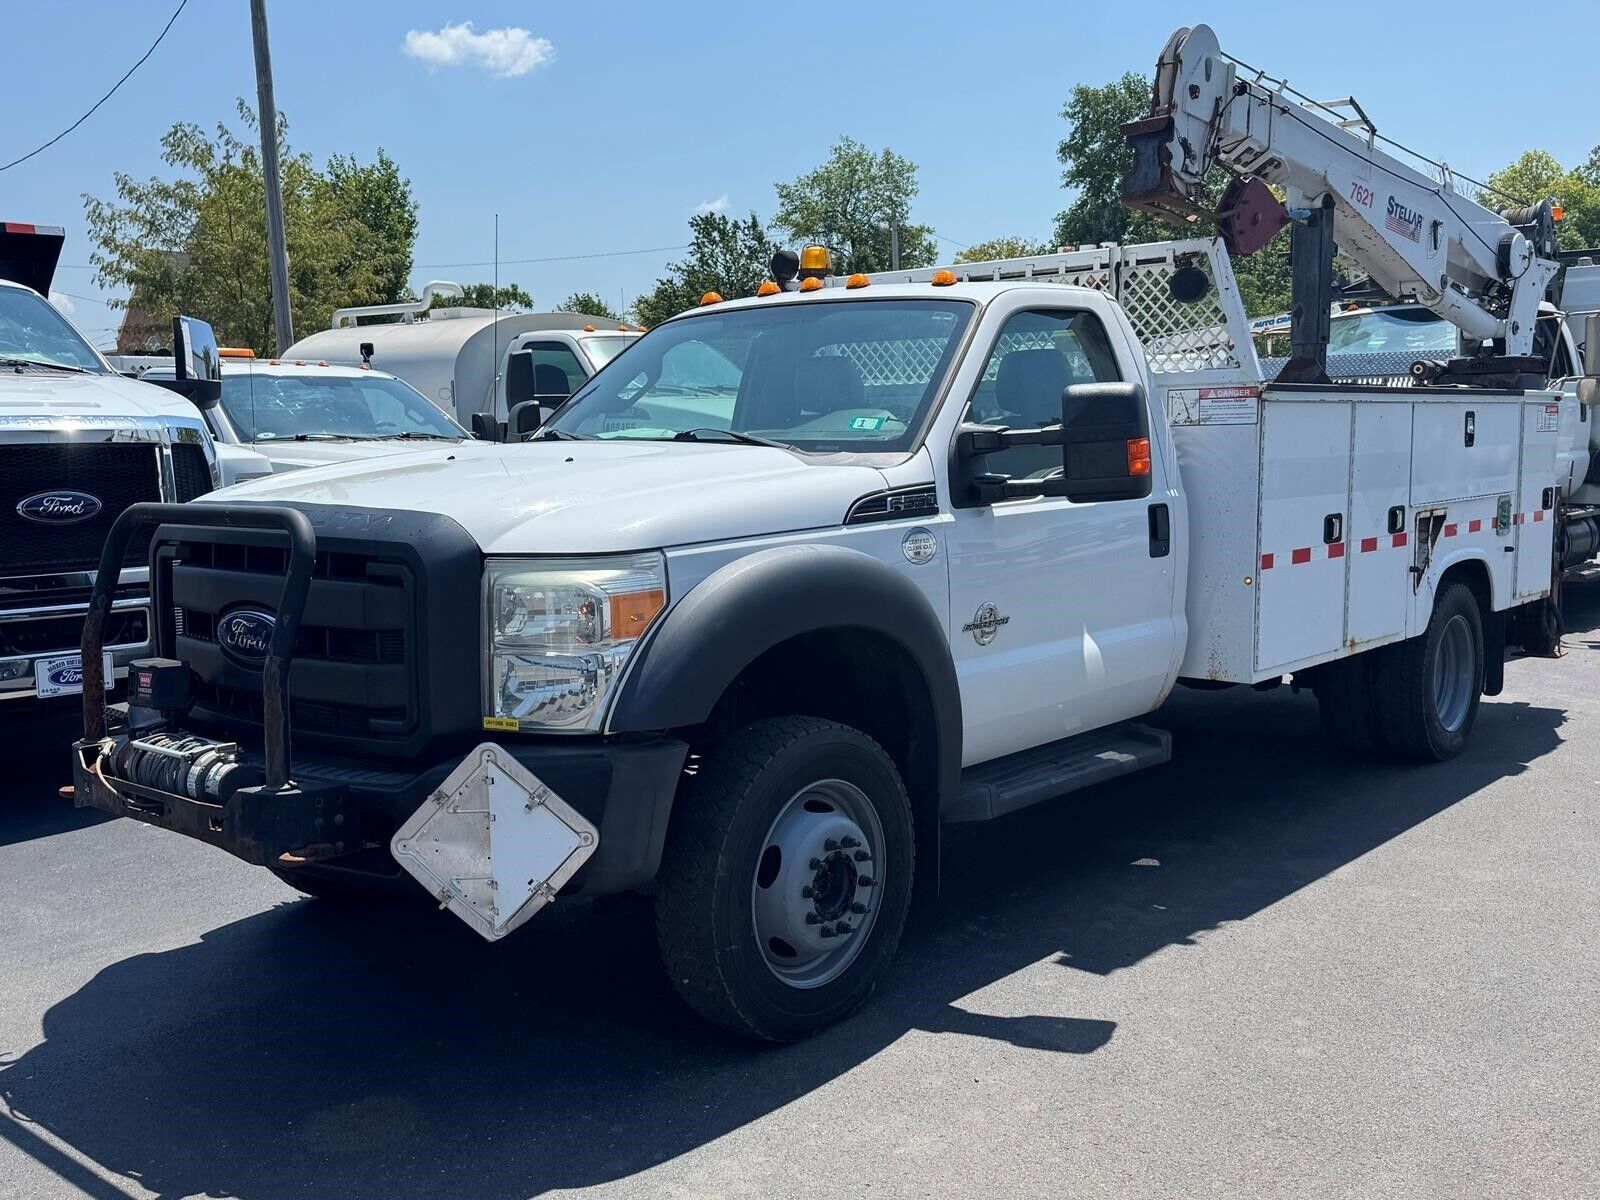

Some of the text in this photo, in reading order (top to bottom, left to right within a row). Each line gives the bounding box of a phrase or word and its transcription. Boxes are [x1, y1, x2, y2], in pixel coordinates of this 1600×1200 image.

[1350, 181, 1374, 209] 7621
[1387, 195, 1423, 230] STELLAR
[1253, 316, 1292, 329] AUTO CRA
[1217, 389, 1250, 398] DANGER
[907, 544, 922, 552] CLEAN
[60, 668, 83, 683] For
